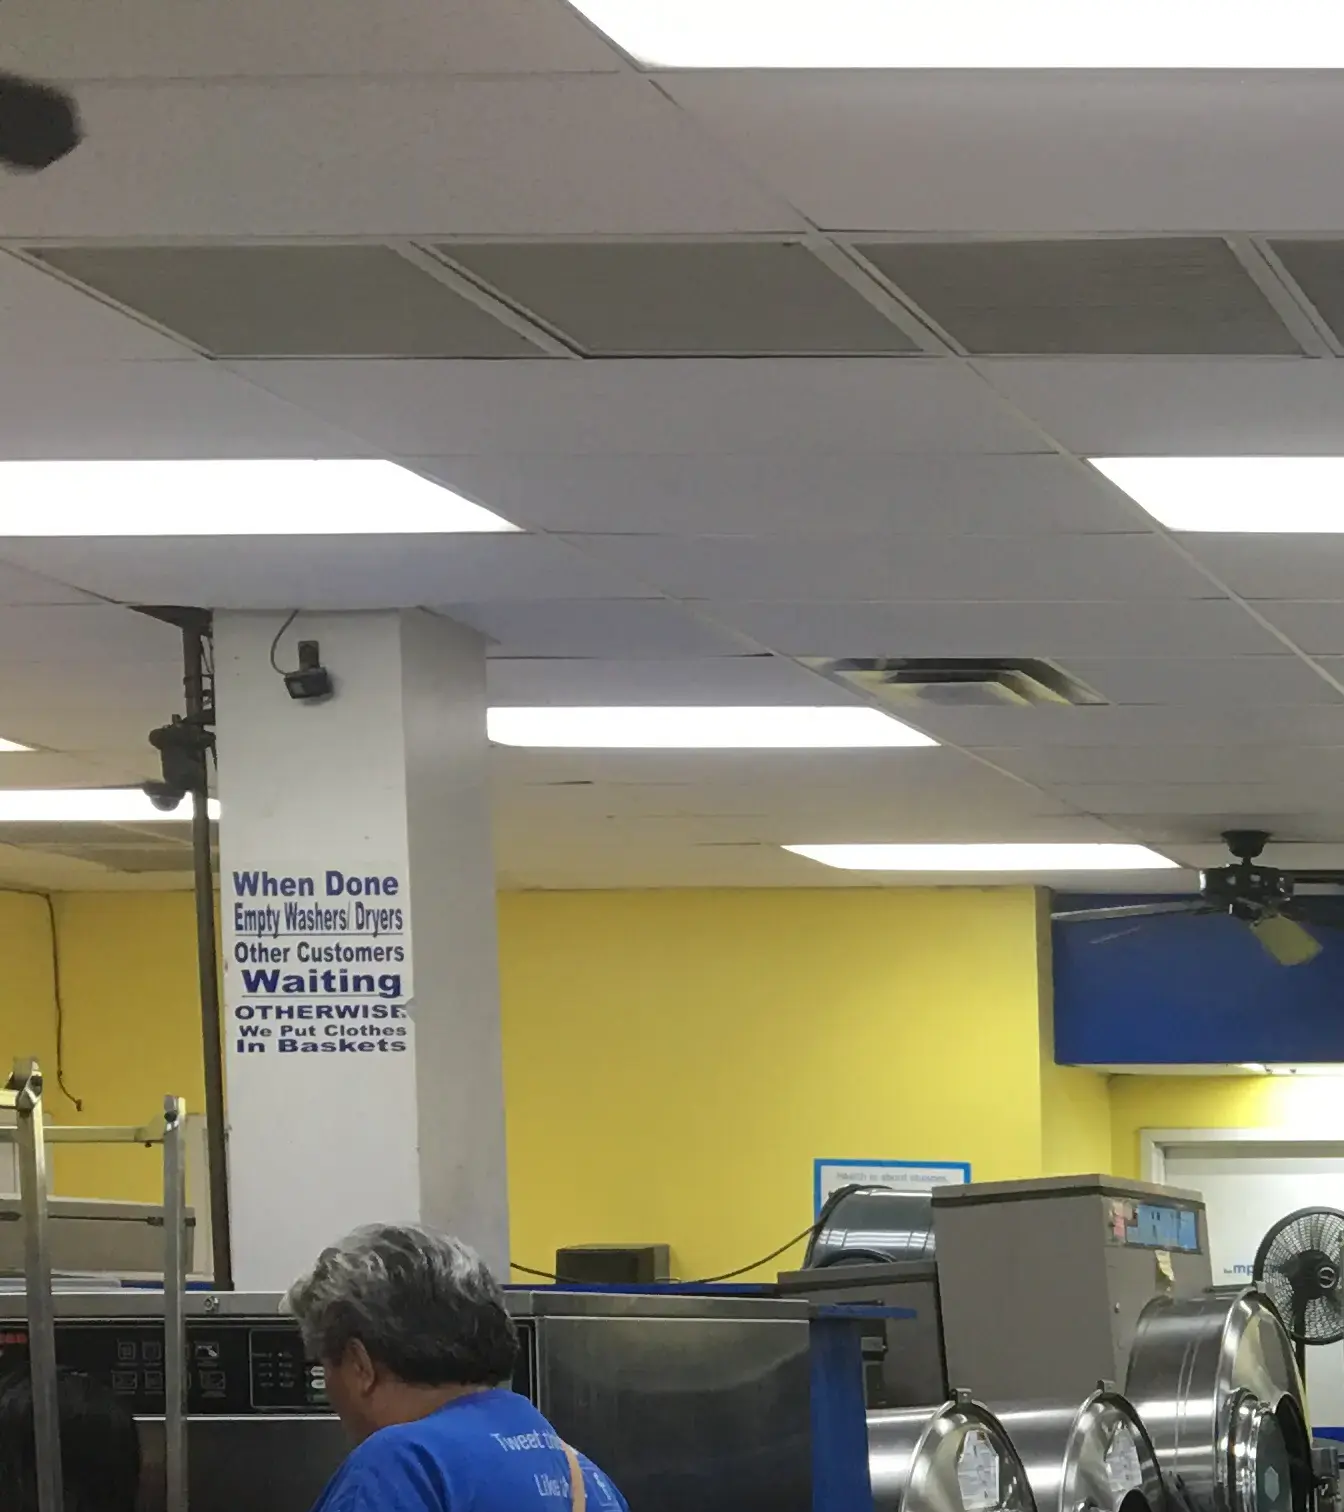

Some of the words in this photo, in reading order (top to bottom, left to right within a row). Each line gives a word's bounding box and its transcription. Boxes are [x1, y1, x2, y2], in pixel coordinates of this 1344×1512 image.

[233, 871, 314, 897] When
[325, 870, 399, 896] Done
[235, 902, 281, 938] Empty
[355, 901, 403, 938] Dryers
[235, 941, 291, 964] Other
[297, 941, 405, 963] Customers
[241, 969, 401, 999] Waiting
[239, 1025, 272, 1037] We
[280, 1025, 316, 1037] Put
[324, 1024, 407, 1037] Clothes
[236, 1039, 265, 1053] In
[278, 1038, 407, 1053] Baskets
[490, 1429, 545, 1452] Tweet
[534, 1473, 560, 1496] Like
